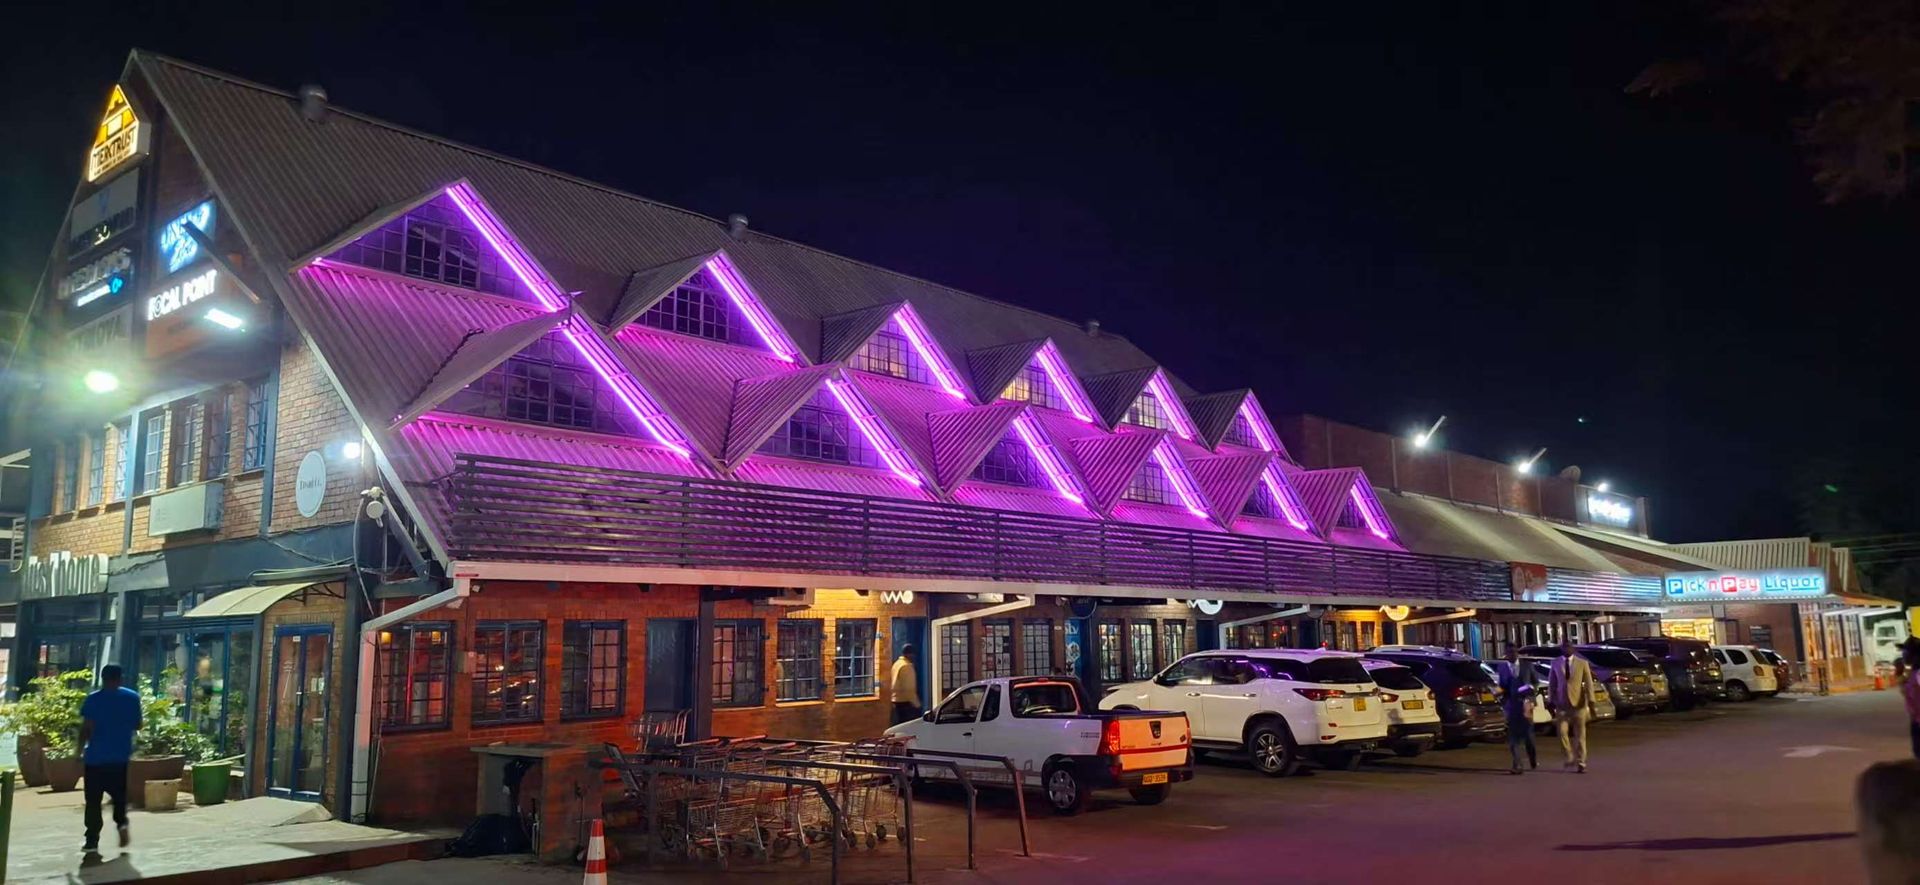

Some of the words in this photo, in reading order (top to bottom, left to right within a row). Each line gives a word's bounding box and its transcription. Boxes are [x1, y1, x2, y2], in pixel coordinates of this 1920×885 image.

[147, 285, 182, 321] FOCAL
[181, 268, 217, 306] POINT
[1668, 577, 1706, 594] Pick
[1707, 580, 1718, 590] n
[1720, 576, 1759, 593] Pay
[1764, 575, 1821, 592] Liquor
